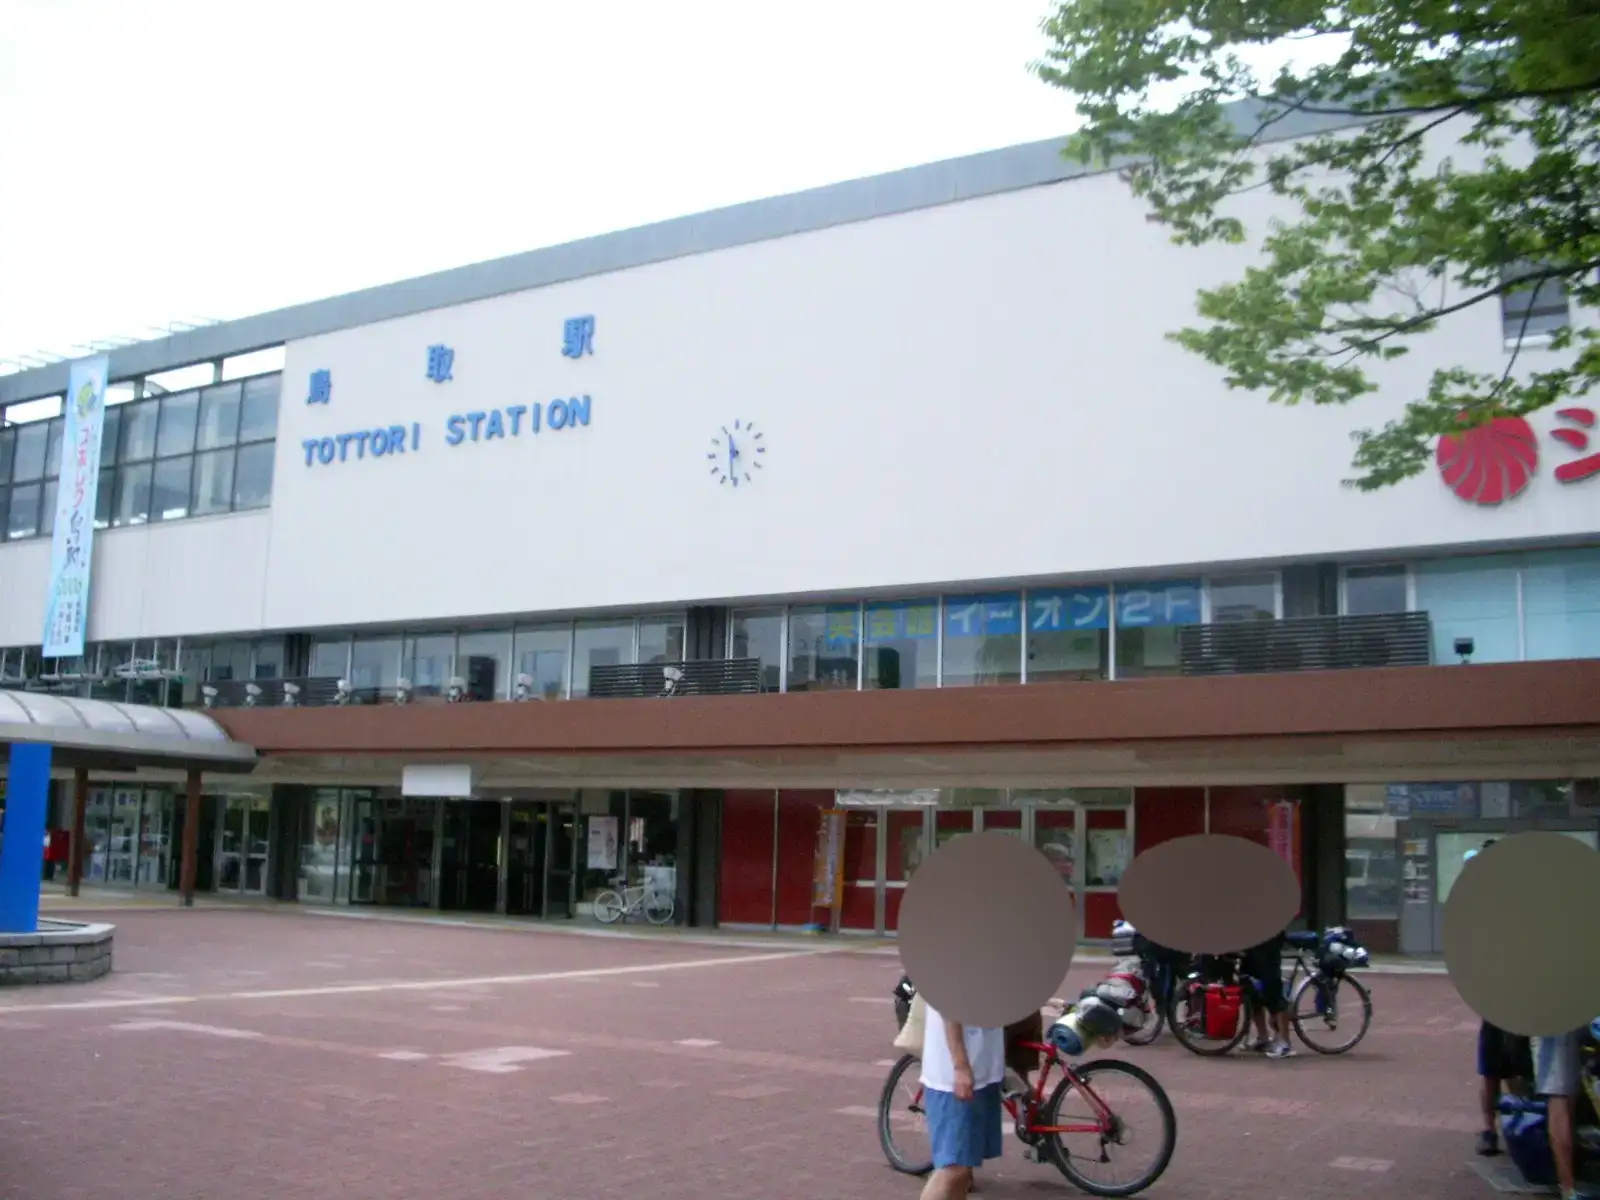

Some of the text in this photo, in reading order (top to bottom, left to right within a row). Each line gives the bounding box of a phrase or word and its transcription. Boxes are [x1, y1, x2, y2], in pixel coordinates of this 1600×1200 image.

[307, 314, 595, 404] 鳥取駅
[302, 395, 592, 467] TOTTORI STATION
